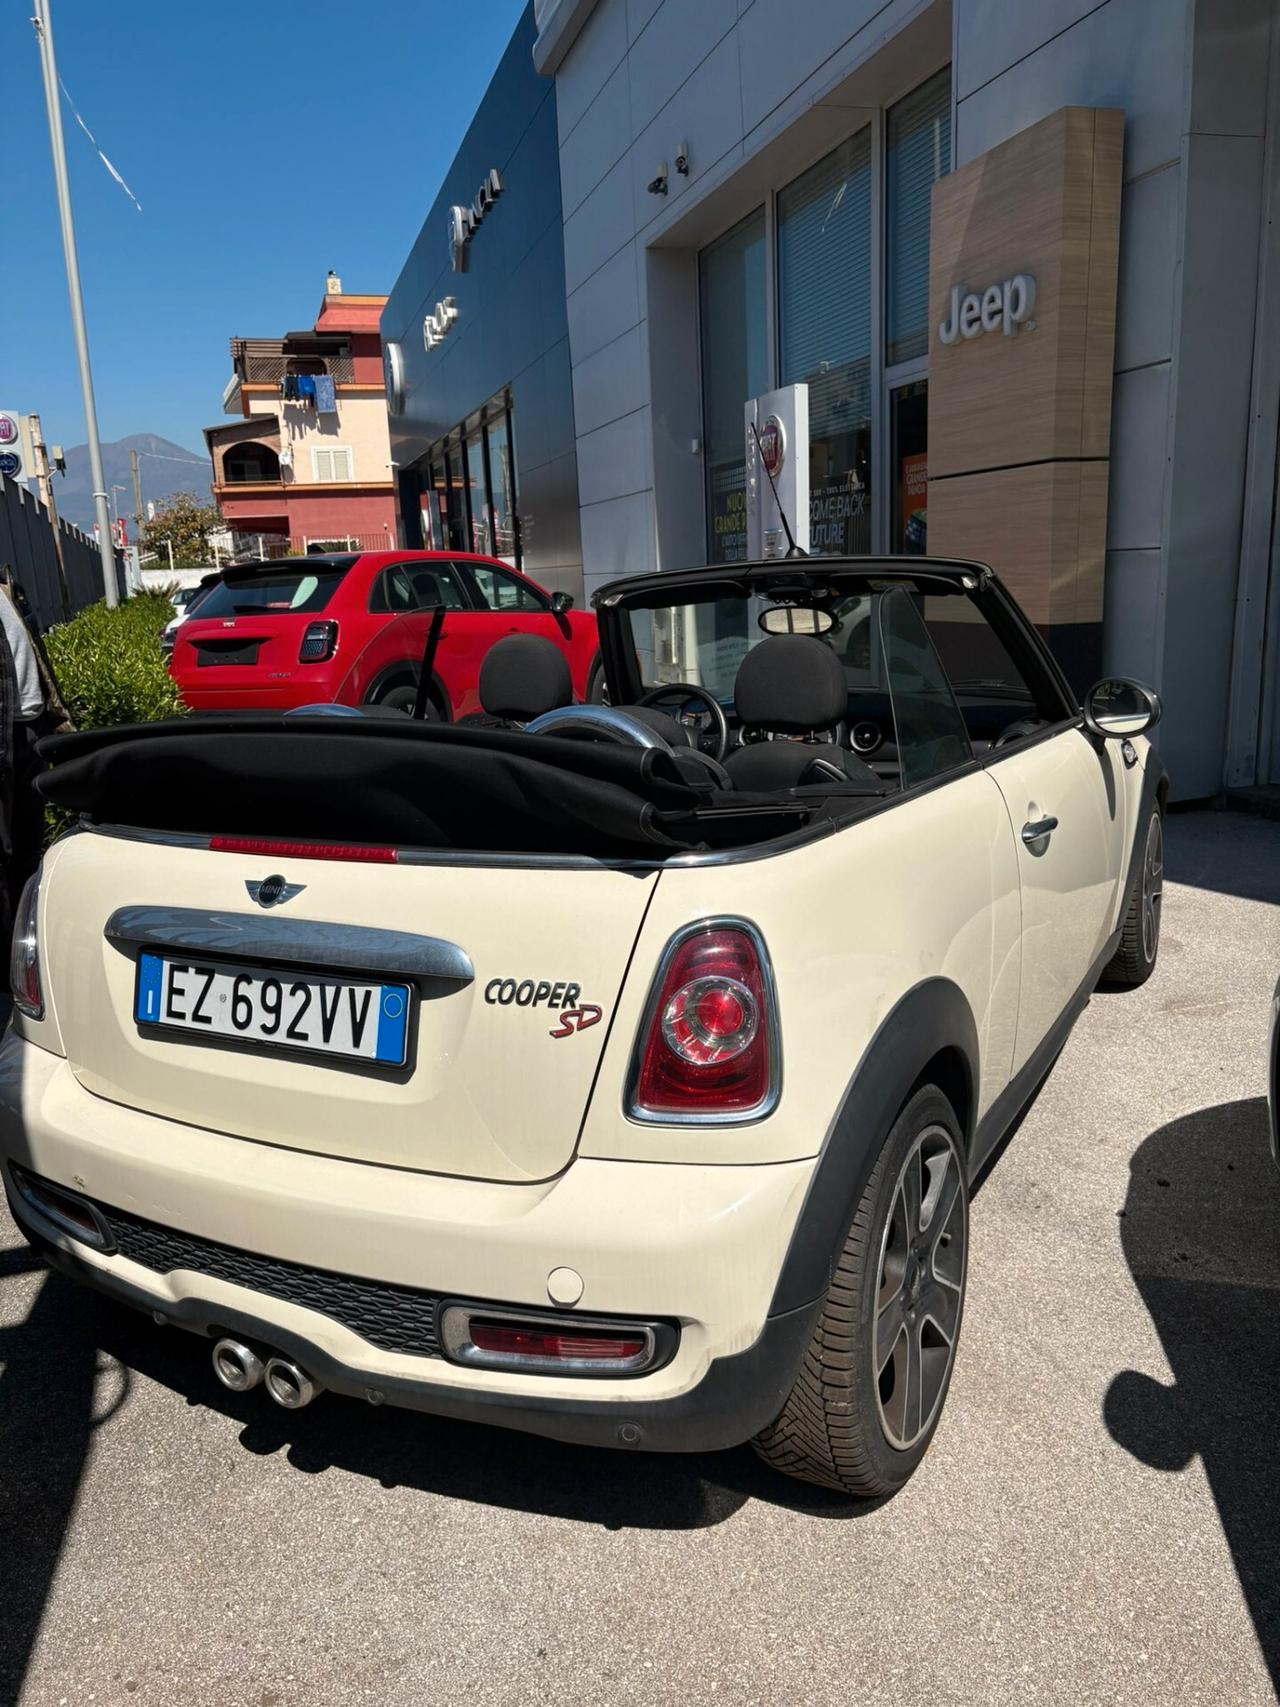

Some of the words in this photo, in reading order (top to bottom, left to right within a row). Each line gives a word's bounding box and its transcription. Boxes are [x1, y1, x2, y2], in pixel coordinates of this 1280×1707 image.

[940, 274, 1034, 345] Jeep
[809, 521, 845, 545] UTURE
[230, 973, 372, 1049] 692VV
[484, 978, 580, 1009] COOPER
[549, 1004, 602, 1039] SD
